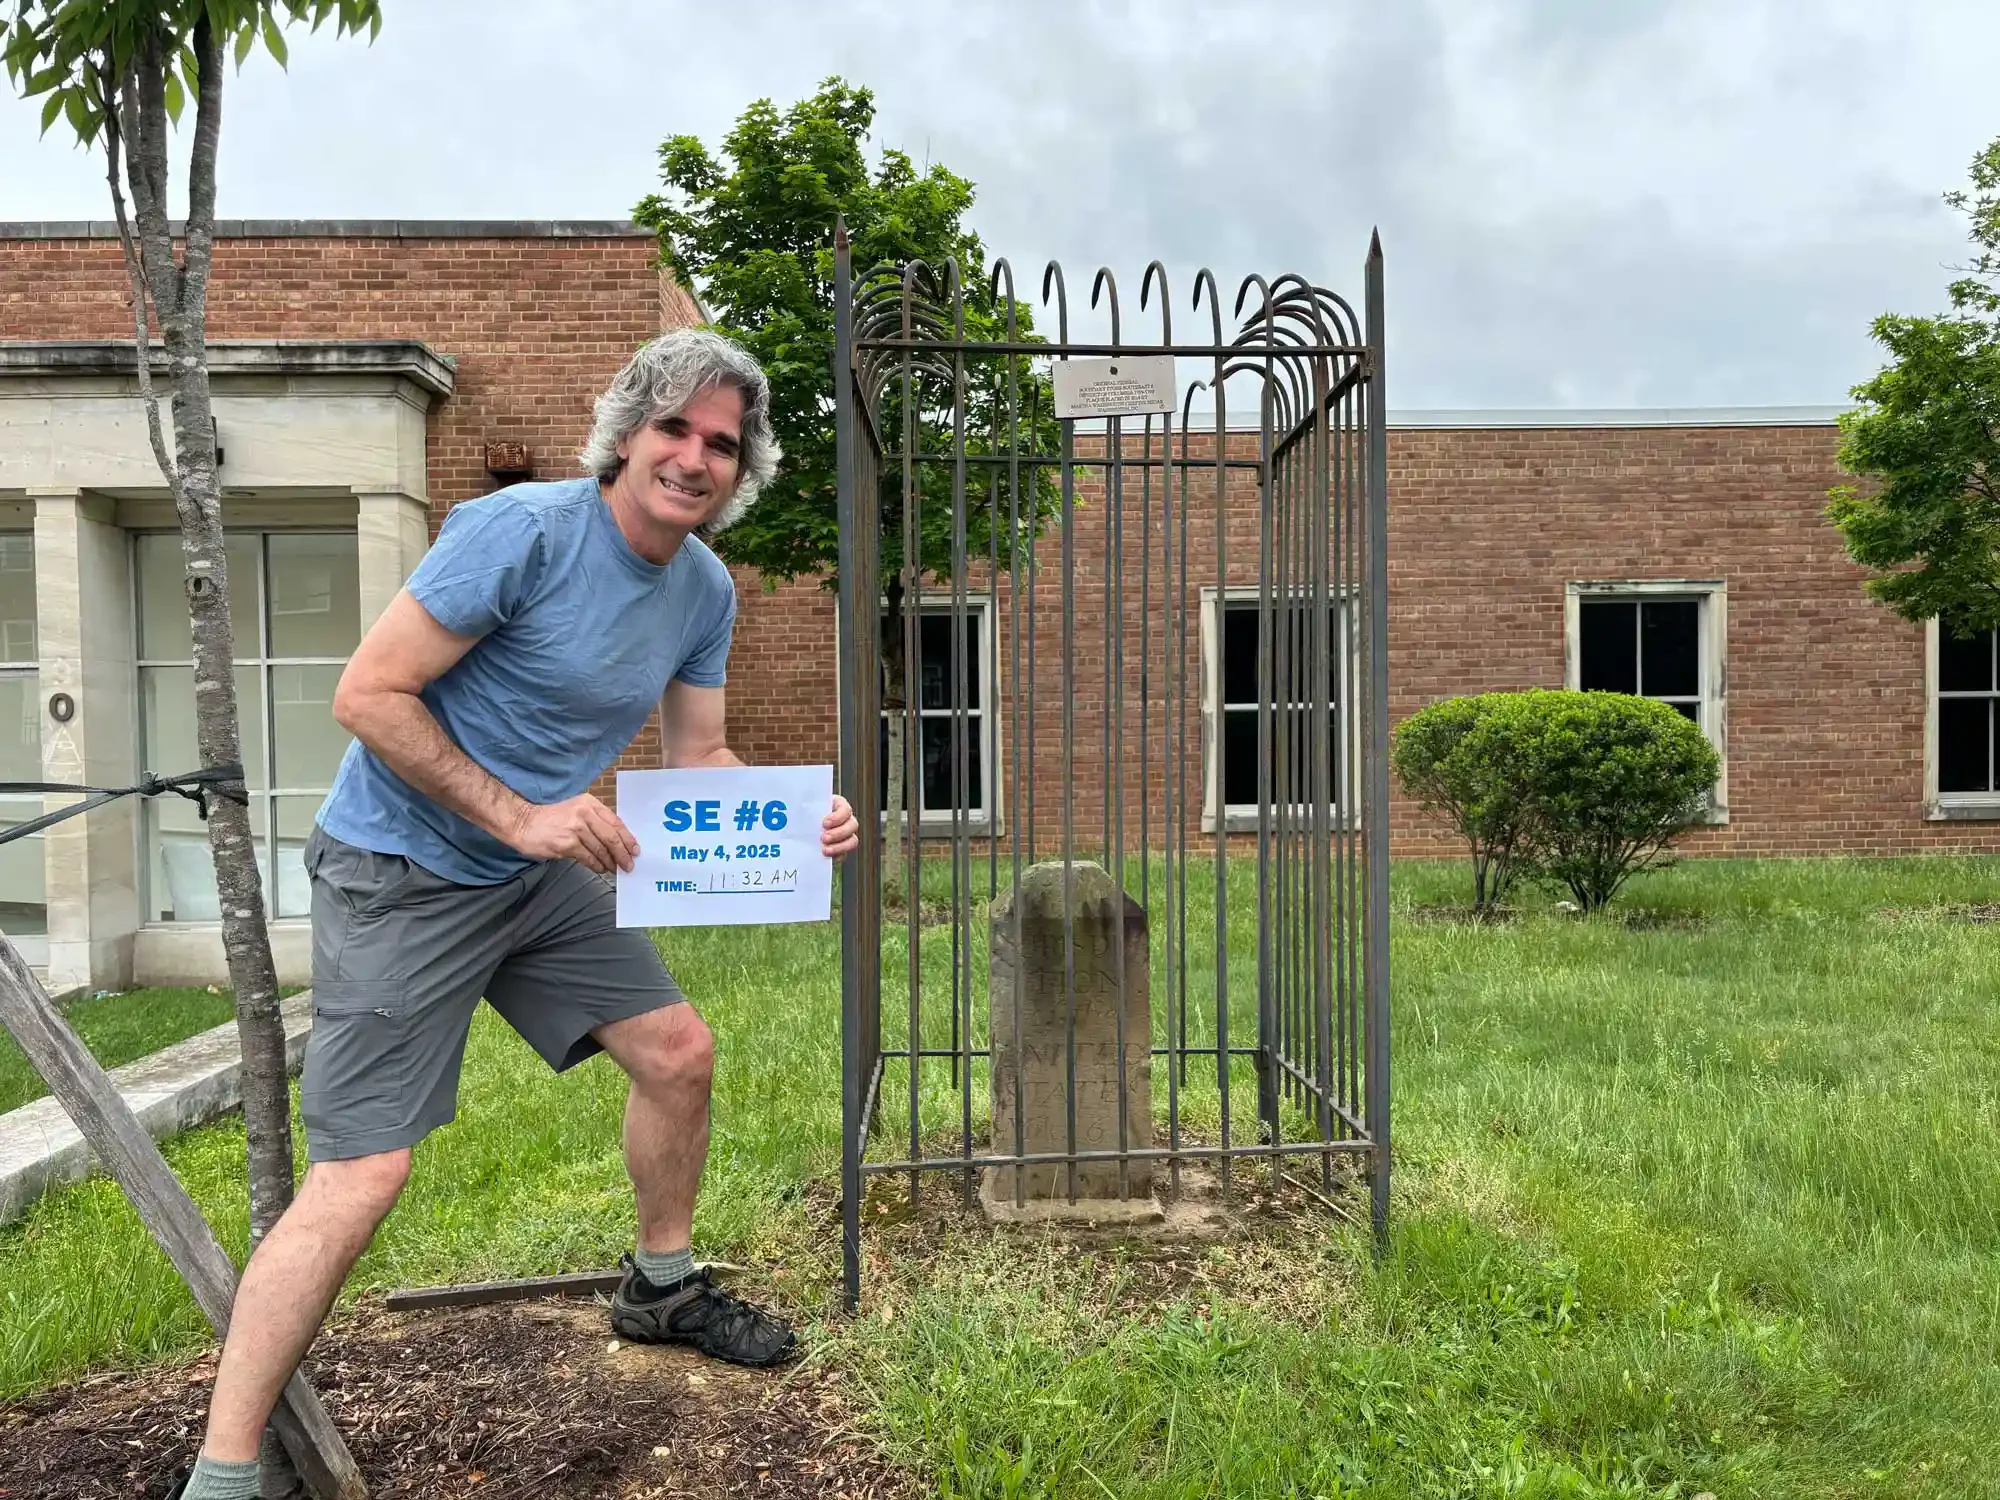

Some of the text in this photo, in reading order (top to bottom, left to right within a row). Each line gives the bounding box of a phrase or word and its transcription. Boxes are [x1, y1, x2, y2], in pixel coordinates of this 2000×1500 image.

[663, 800, 788, 832] SE #6
[671, 844, 781, 862] May 4, 2025
[655, 867, 799, 892] TIME: 11:32 AM
